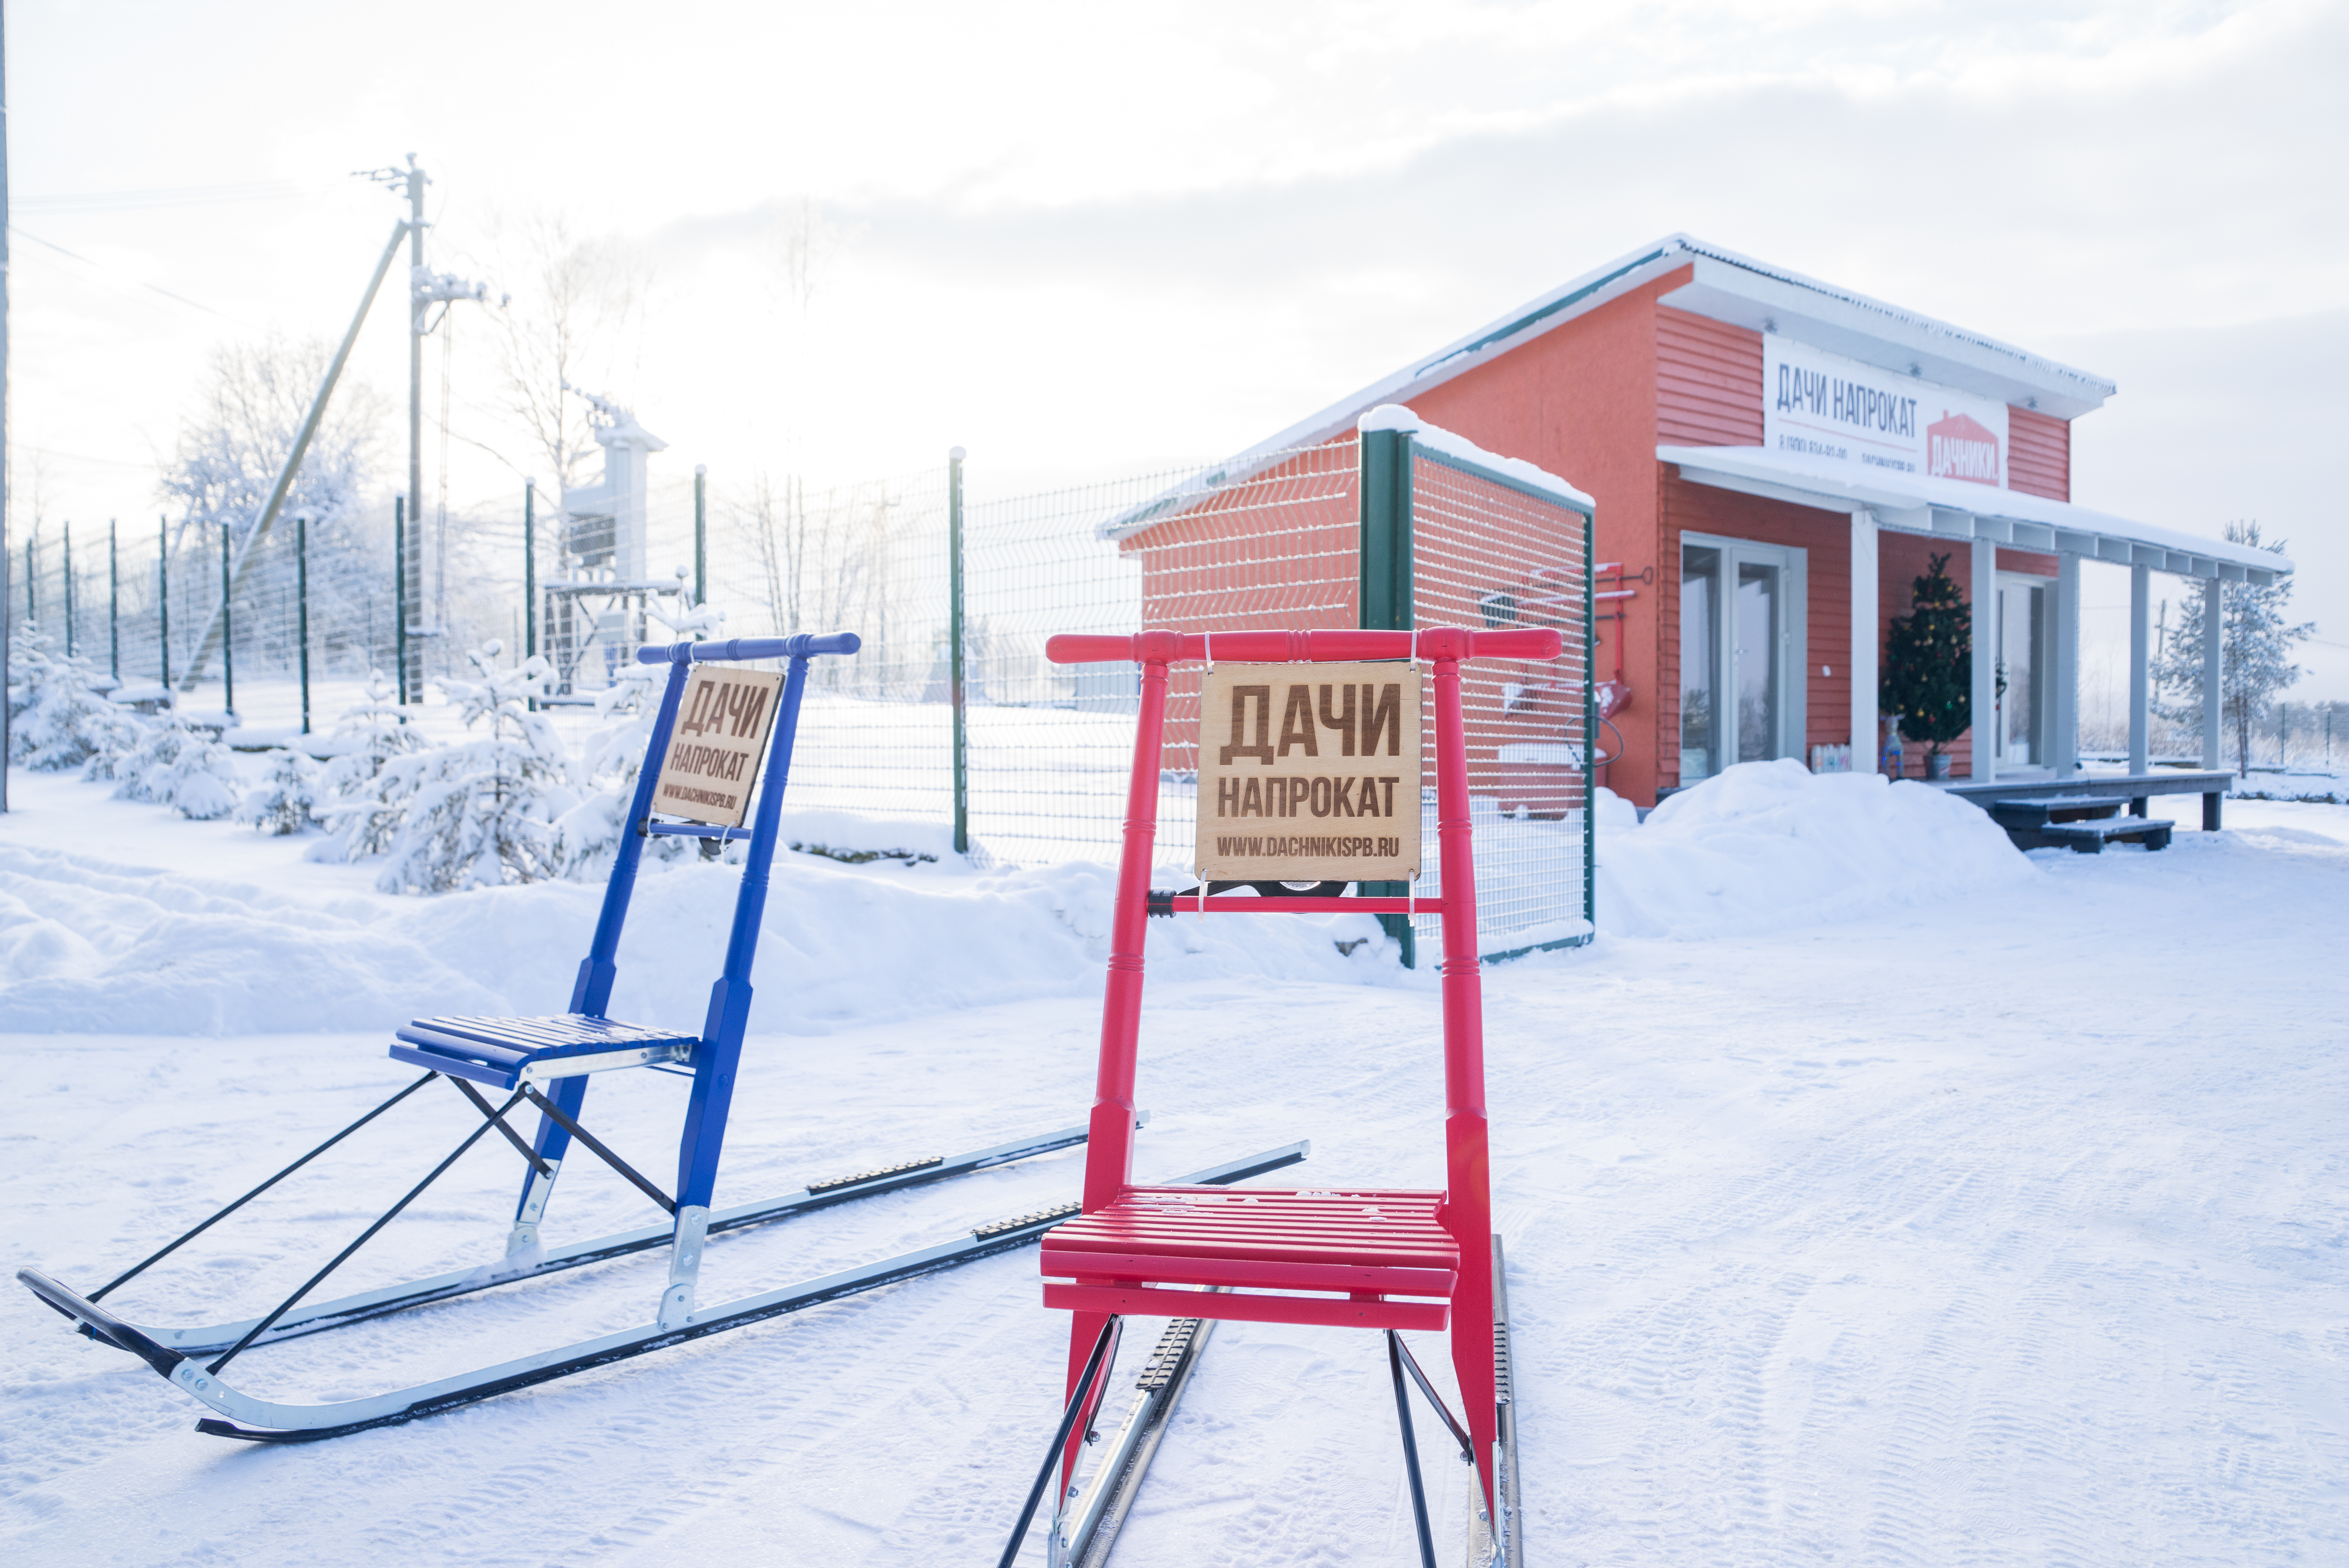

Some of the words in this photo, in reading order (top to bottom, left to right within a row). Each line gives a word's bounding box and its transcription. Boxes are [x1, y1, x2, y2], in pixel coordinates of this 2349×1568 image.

[1778, 364, 1826, 416] ДАЧИ
[1833, 379, 1917, 438] НАПРОКАТ
[681, 681, 769, 739] ДАЧИ
[1220, 684, 1400, 765] ДАЧИ
[669, 742, 749, 782] НАПРОКАТ
[663, 783, 736, 809] WWW.DACHNIKISPB.RU
[1217, 776, 1399, 817] НАПРОКАТ
[1217, 837, 1399, 857] WWW.DACHNIKISPB.RU
